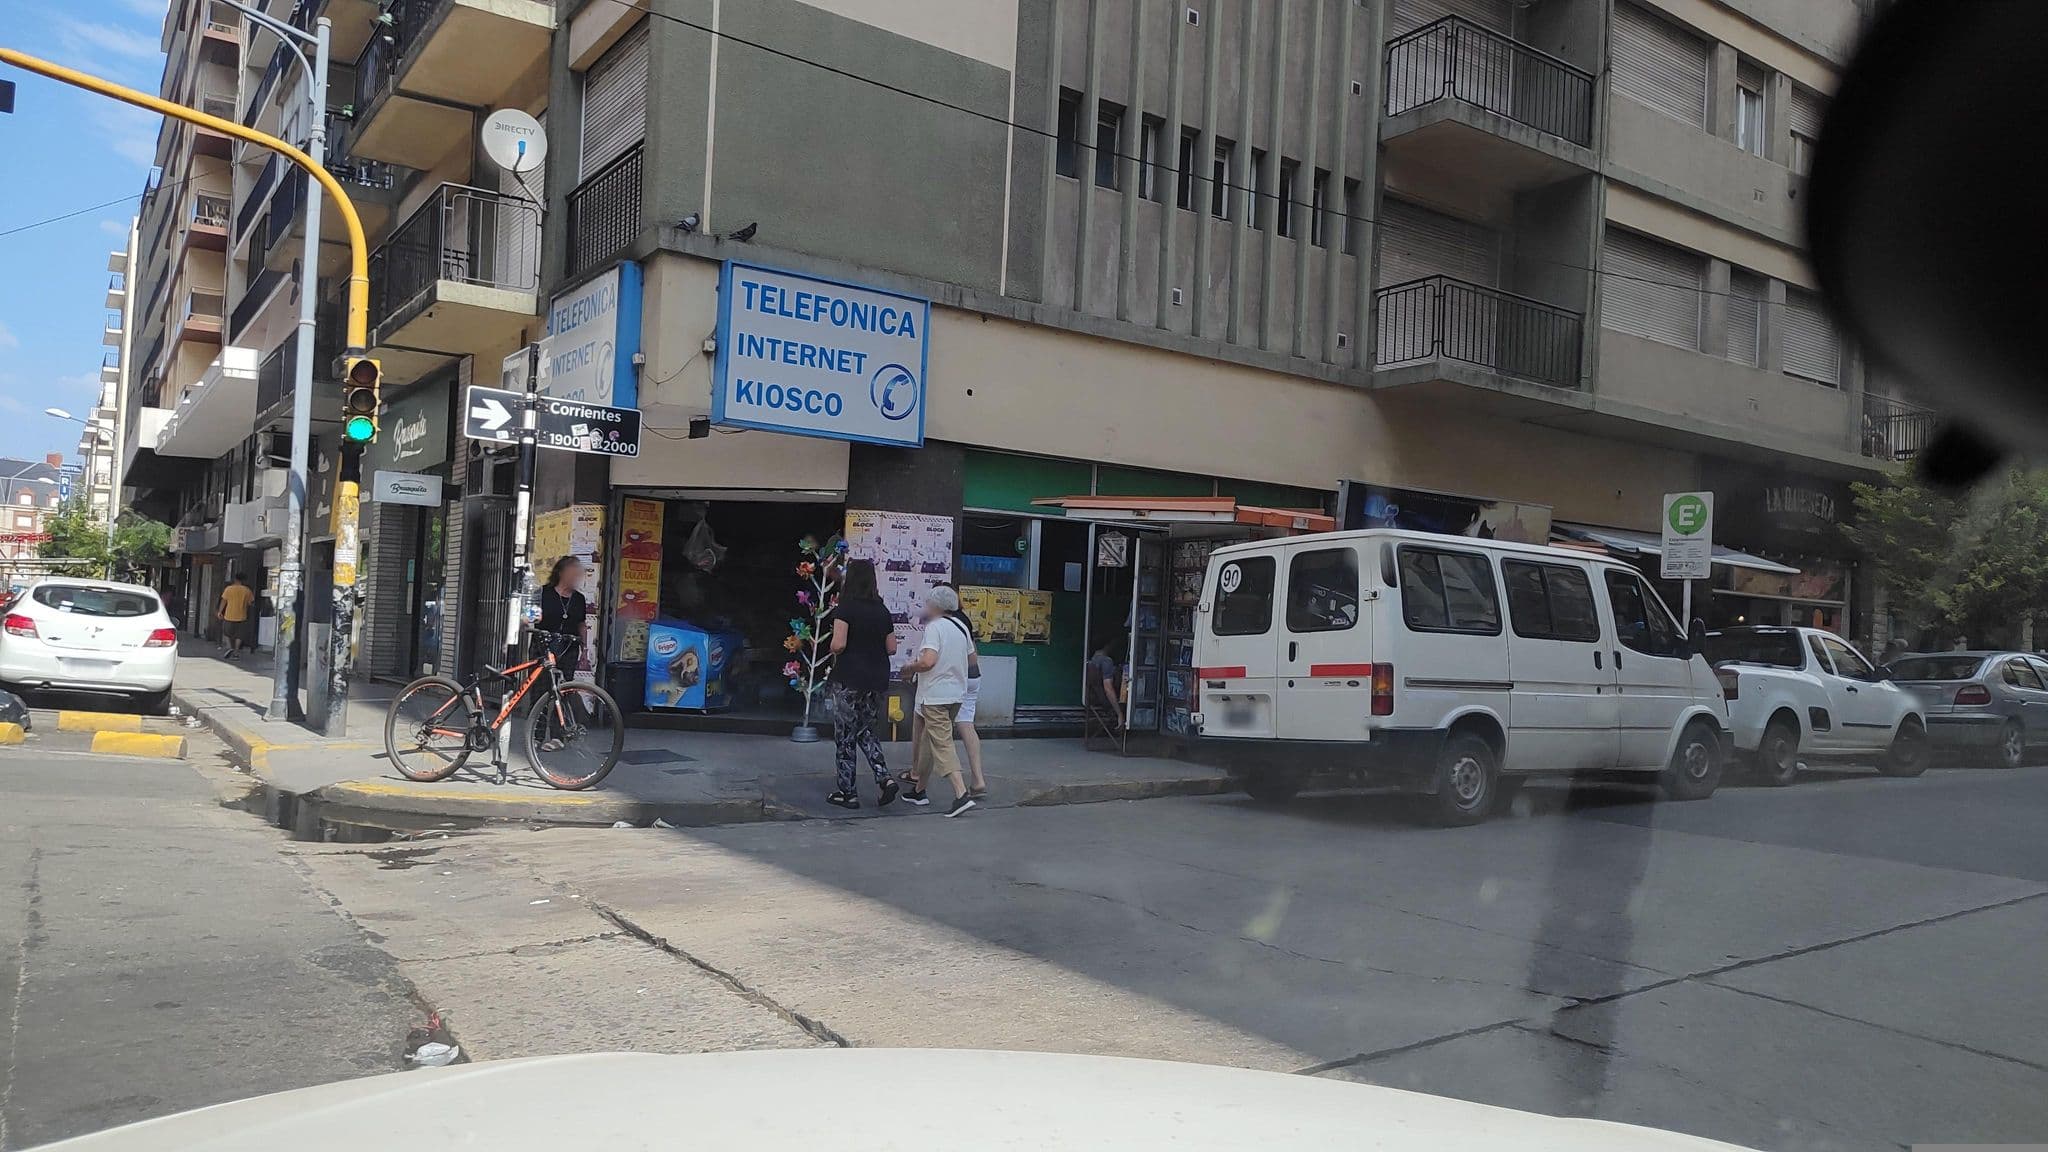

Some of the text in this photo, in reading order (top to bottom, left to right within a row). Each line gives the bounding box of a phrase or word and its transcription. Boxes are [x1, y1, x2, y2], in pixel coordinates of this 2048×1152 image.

[495, 122, 535, 135] DIRECTV
[555, 282, 616, 337] TELEFONICA
[741, 280, 915, 338] TELEFONICA
[552, 341, 596, 377] INTERNET
[738, 332, 867, 375] INTERNET
[550, 402, 622, 423] Corrientes
[736, 378, 843, 417] KIOSCO
[550, 432, 637, 454] 1900 2000
[1223, 569, 1239, 588] 90
